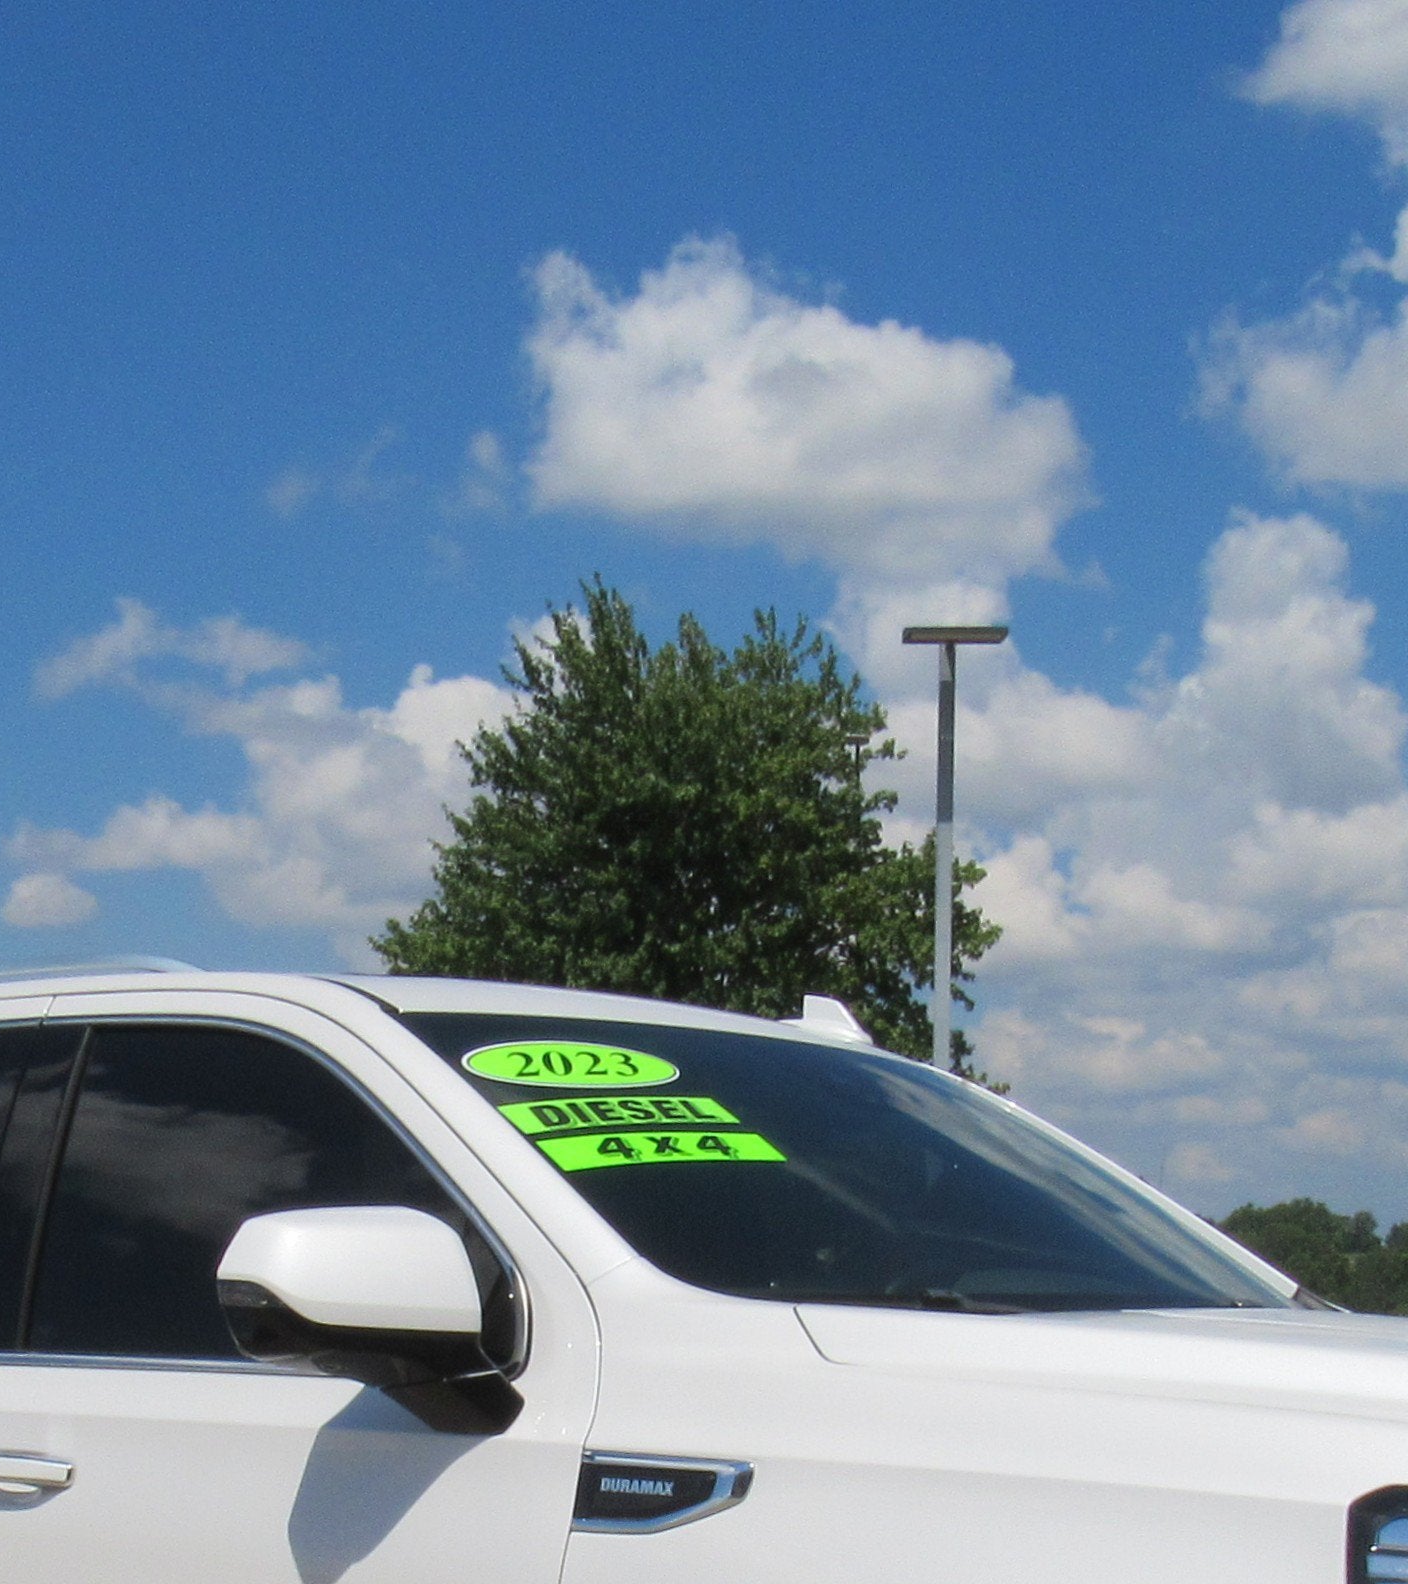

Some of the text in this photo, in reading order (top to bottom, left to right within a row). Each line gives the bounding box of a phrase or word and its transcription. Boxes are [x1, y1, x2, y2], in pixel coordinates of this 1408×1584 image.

[506, 1050, 639, 1078] 2023
[528, 1099, 716, 1128] DIESEL
[599, 1476, 675, 1497] DURAMAX
